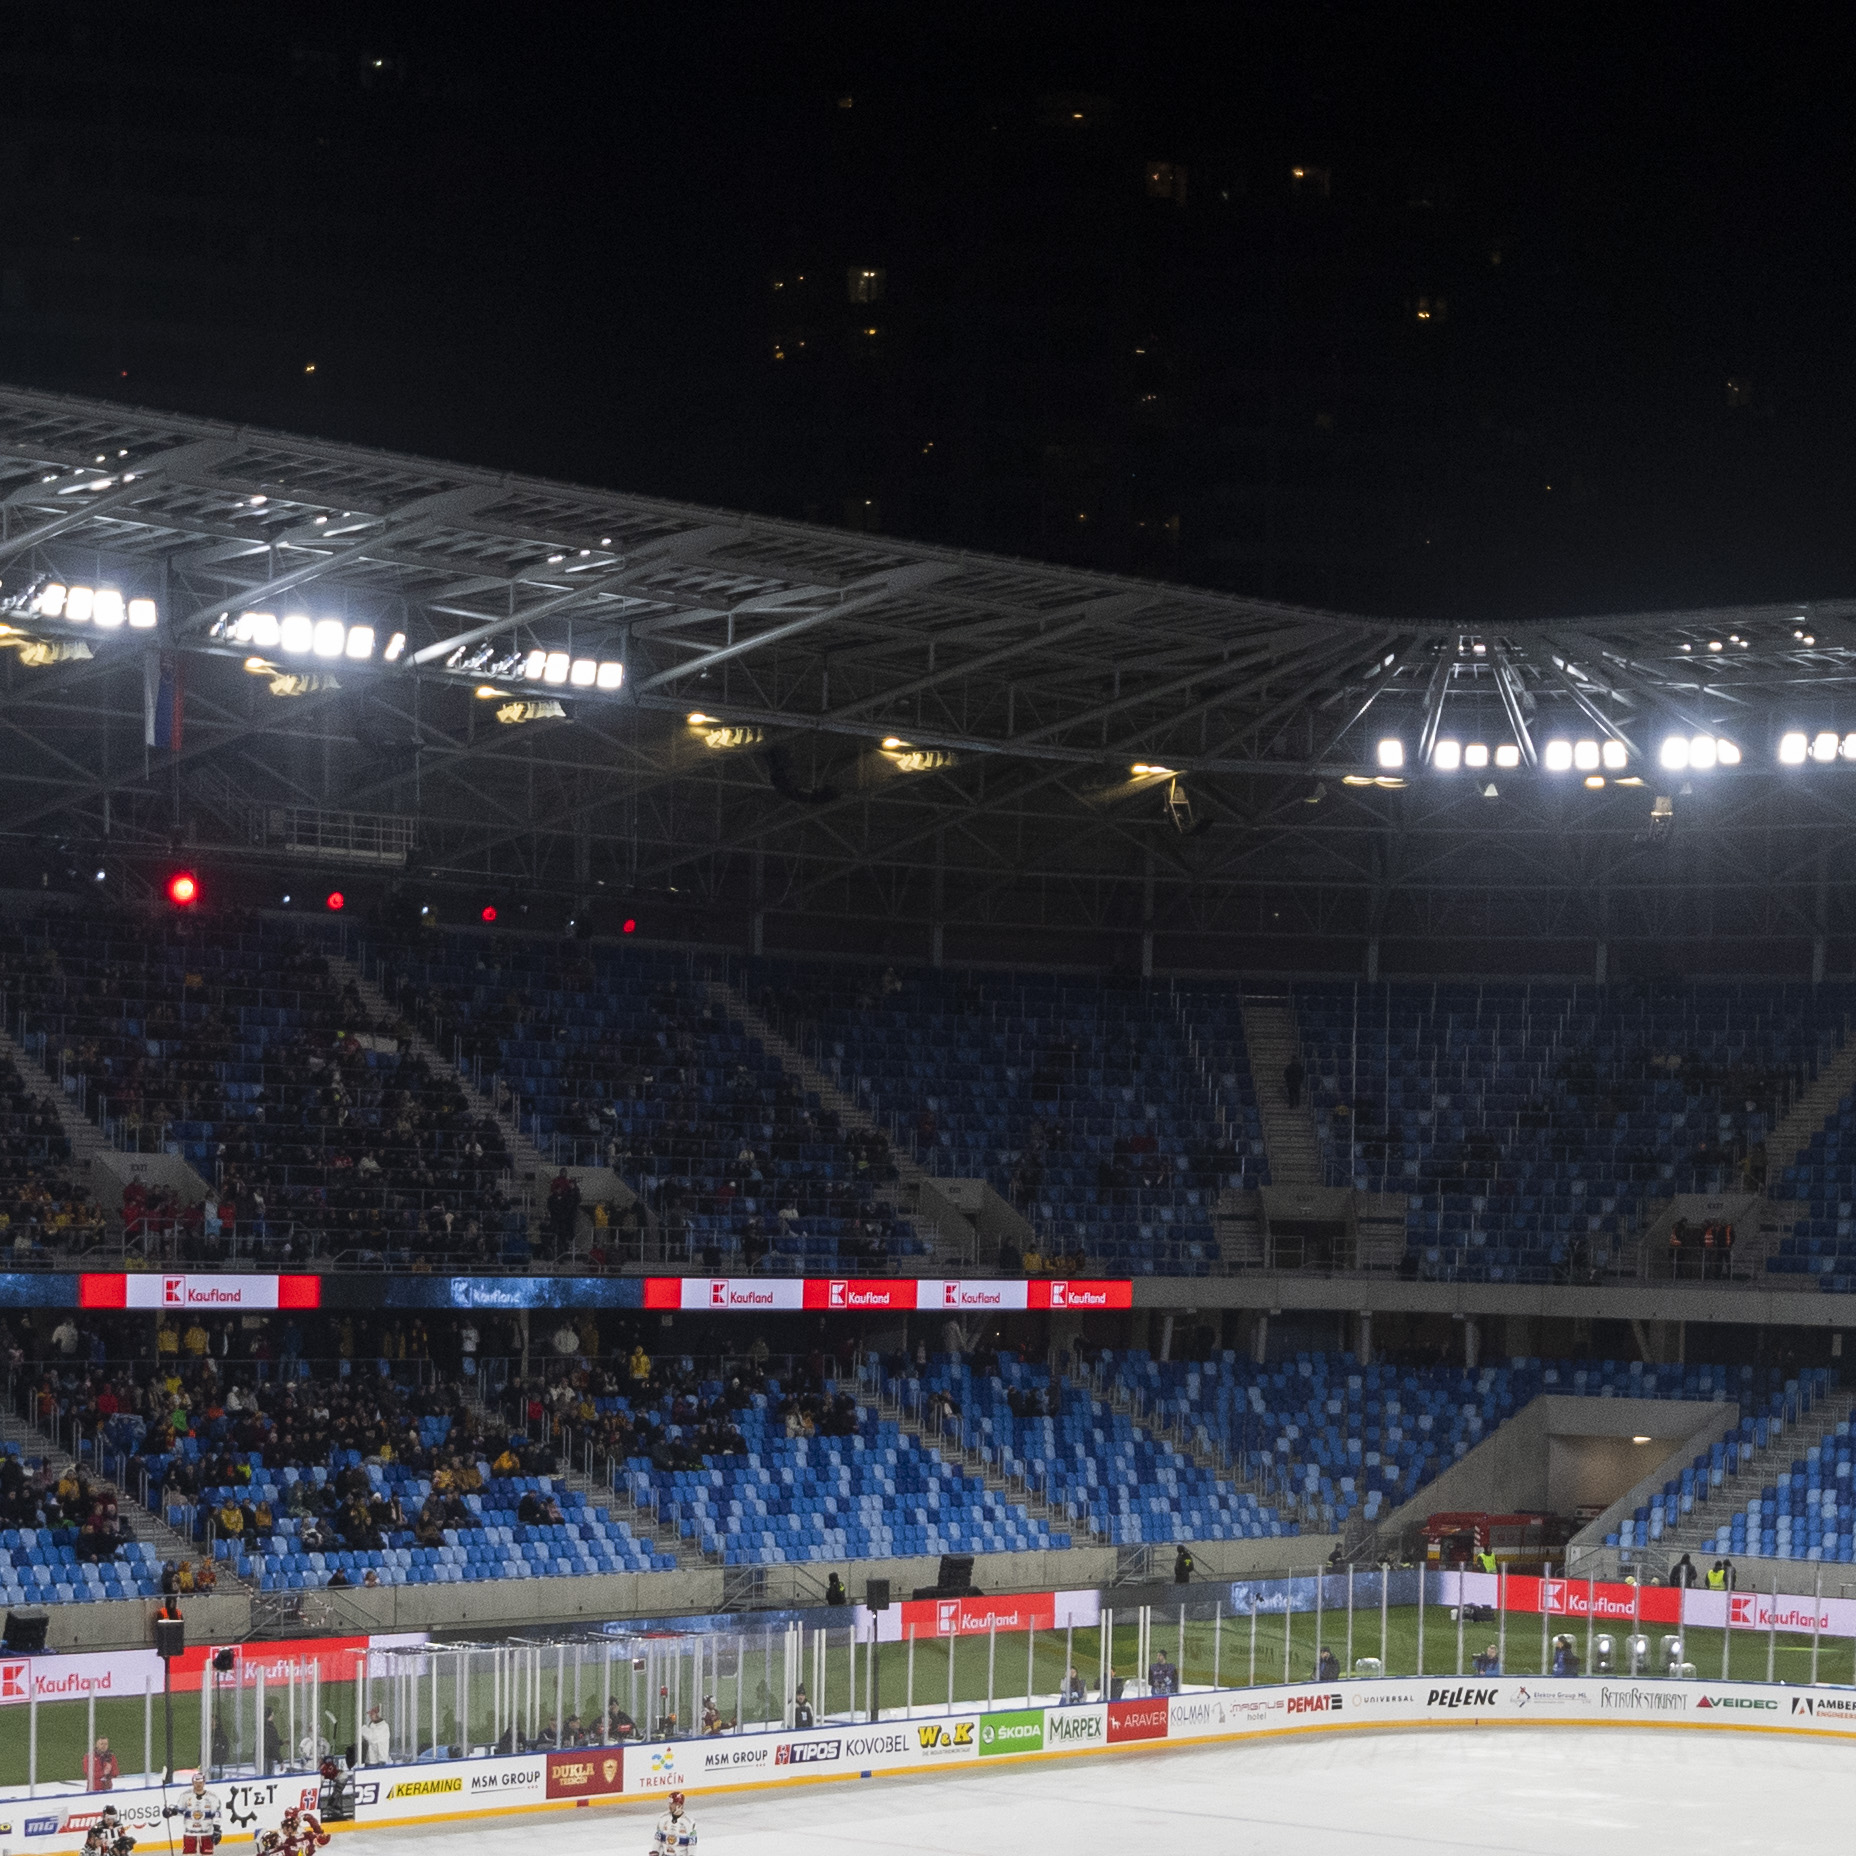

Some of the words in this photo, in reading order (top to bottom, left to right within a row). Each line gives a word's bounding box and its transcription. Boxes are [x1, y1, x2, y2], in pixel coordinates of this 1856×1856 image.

[187, 1288, 241, 1303] Kaufland
[730, 1290, 774, 1304] Kaufland
[848, 1292, 890, 1305] Kaufland
[961, 1292, 1000, 1305] Kaufland
[1068, 1292, 1106, 1305] Kaufland
[1569, 1595, 1635, 1615] Kaufland
[1759, 1610, 1829, 1629] Kaufland
[36, 1672, 112, 1694] Kaufland
[1427, 1687, 1499, 1708] PELLENC
[1710, 1697, 1778, 1710] VEIDEC
[1124, 1711, 1167, 1728] ARAVER
[998, 1723, 1042, 1739] ŠKODA
[793, 1742, 839, 1761] TIPOS
[845, 1735, 910, 1757] KOVOBEL
[705, 1752, 731, 1767] MSM
[732, 1749, 768, 1765] GROUP
[471, 1774, 498, 1789] MSM
[501, 1770, 541, 1787] GROUP
[552, 1763, 595, 1779] DUKLA
[396, 1778, 463, 1797] KERAMING
[640, 1773, 685, 1789] TRENČÍN
